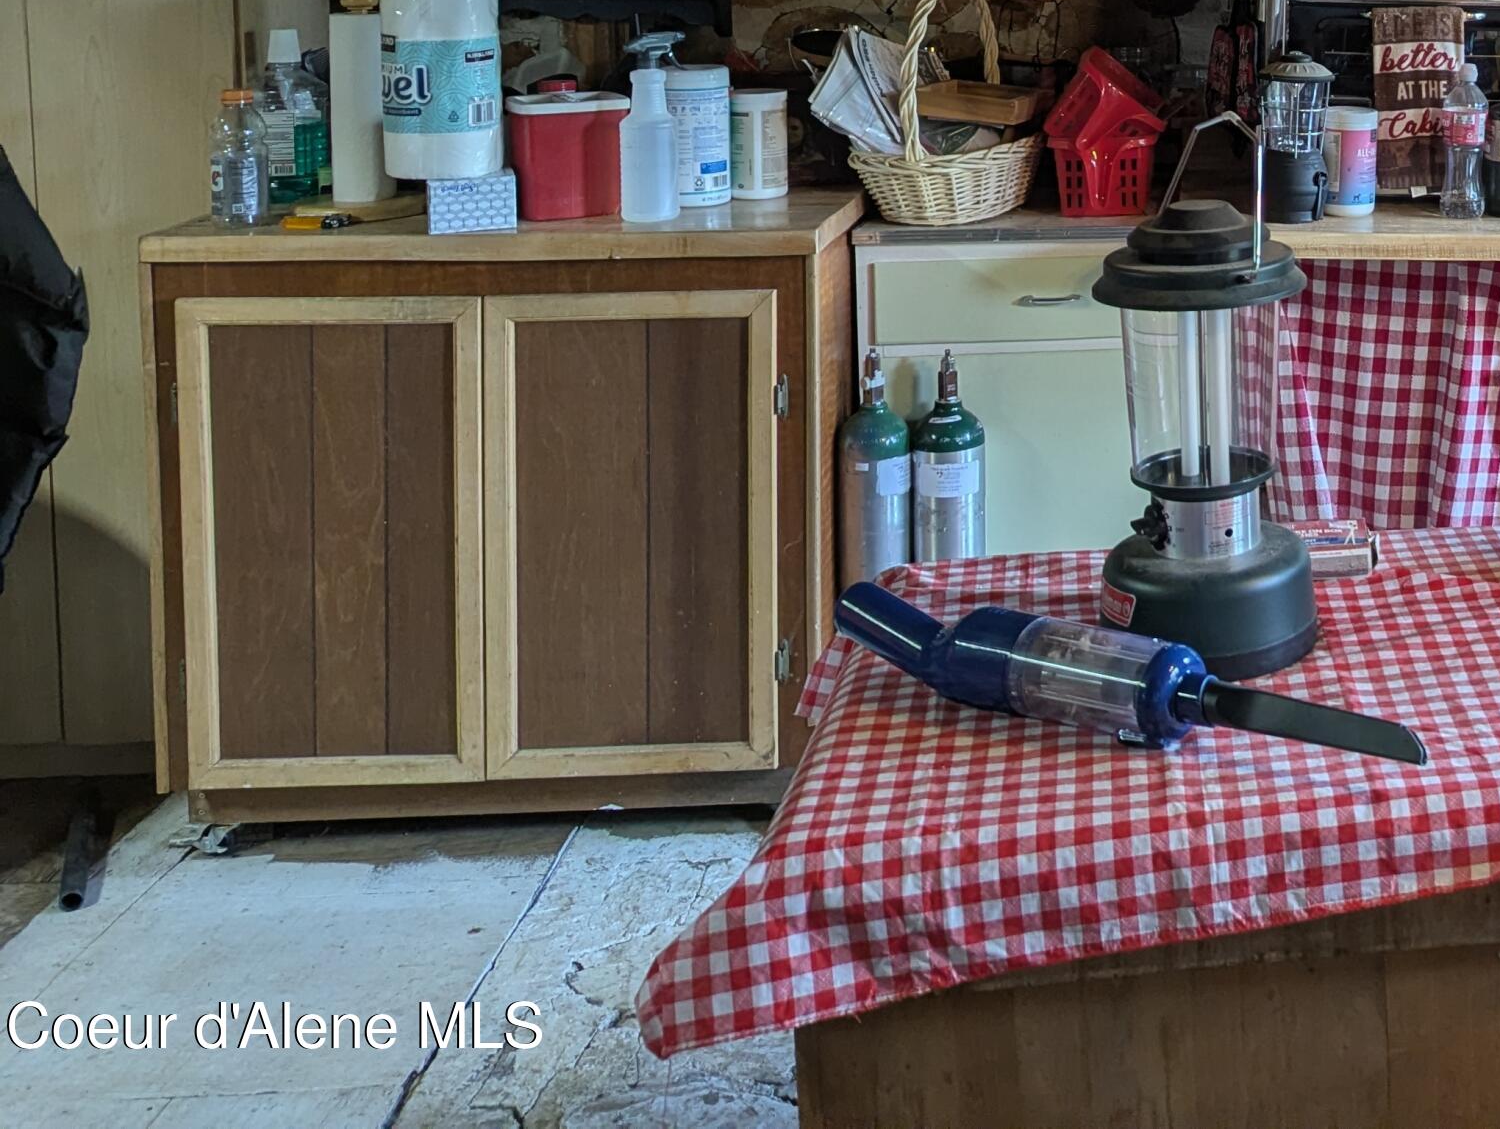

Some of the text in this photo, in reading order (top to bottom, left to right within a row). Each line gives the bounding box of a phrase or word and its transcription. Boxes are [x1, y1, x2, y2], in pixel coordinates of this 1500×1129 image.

[1379, 42, 1459, 73] better
[1397, 78, 1448, 102] AT THE
[1377, 111, 1444, 140] Cabi
